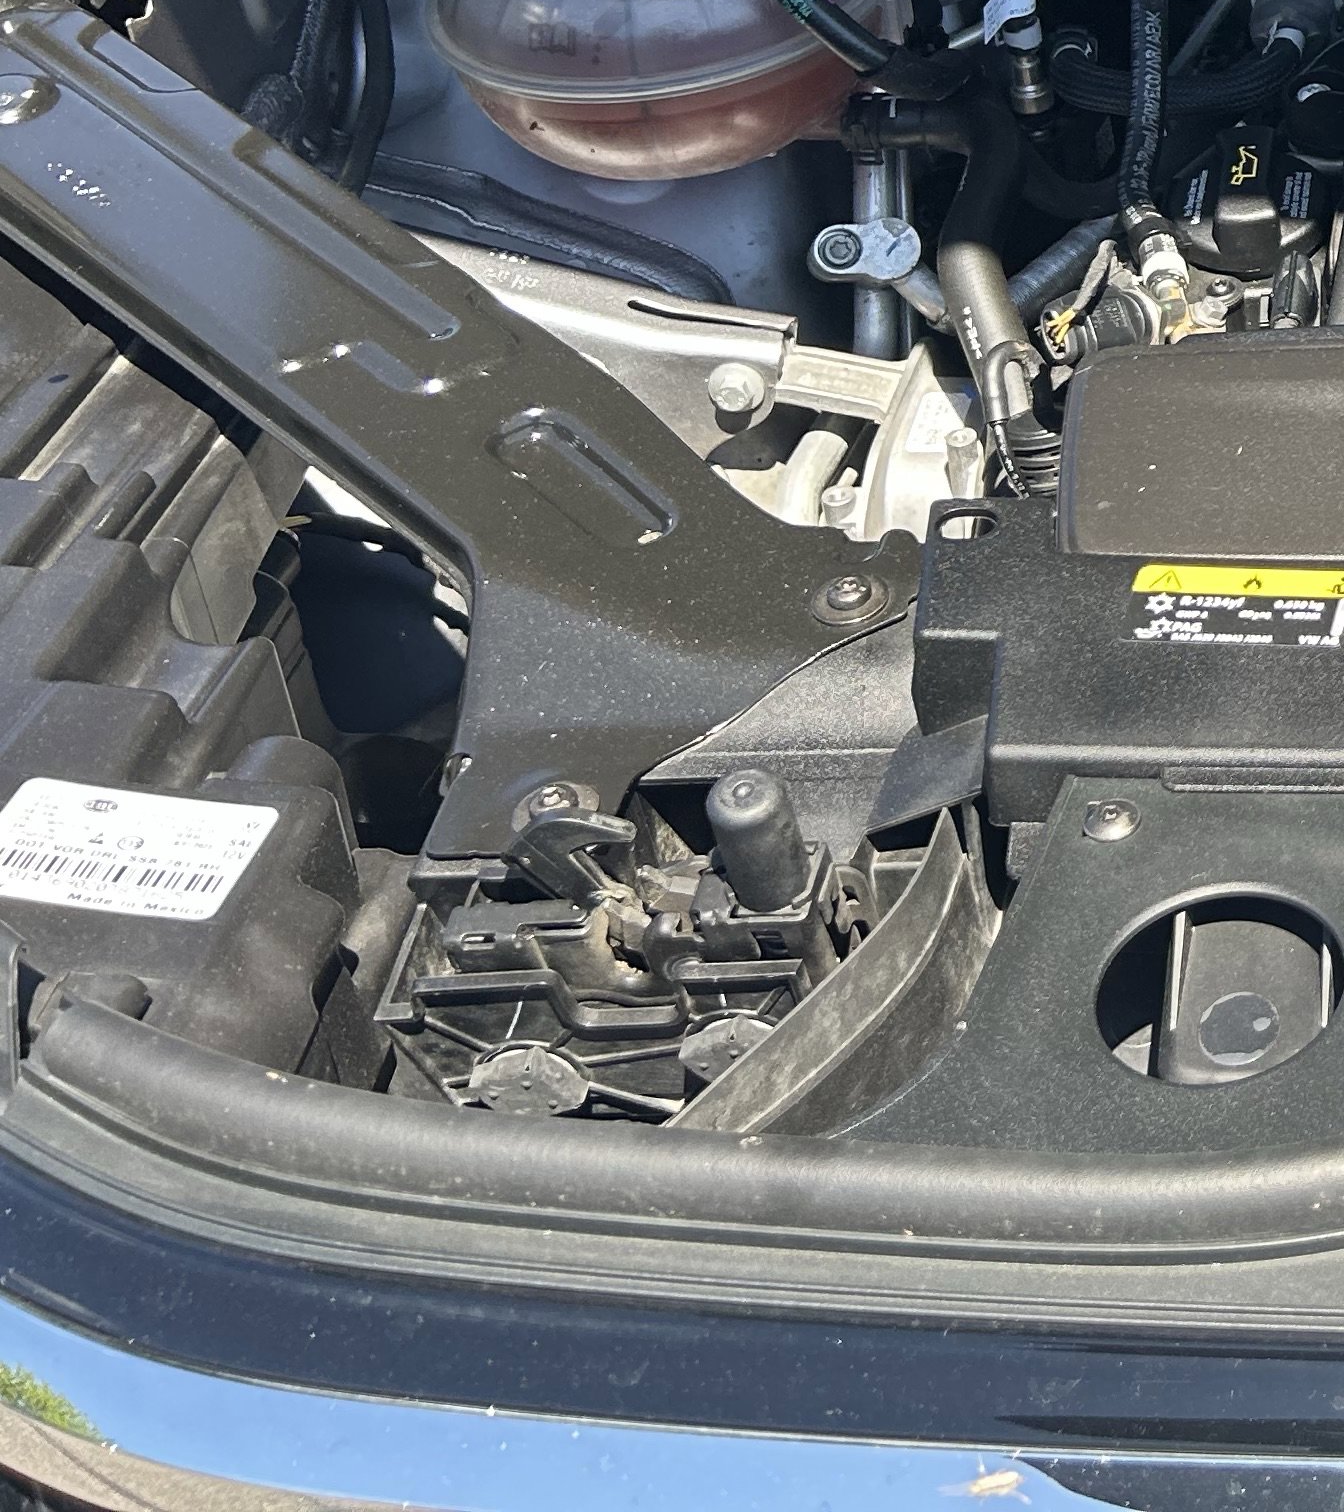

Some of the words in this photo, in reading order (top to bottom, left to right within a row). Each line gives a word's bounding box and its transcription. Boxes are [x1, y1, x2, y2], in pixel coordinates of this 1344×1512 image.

[1179, 595, 1246, 610] R-1234yf
[1171, 621, 1203, 633] PAG
[1298, 634, 1321, 646] VW
[67, 892, 113, 906] Made
[143, 902, 204, 915] Mexico
